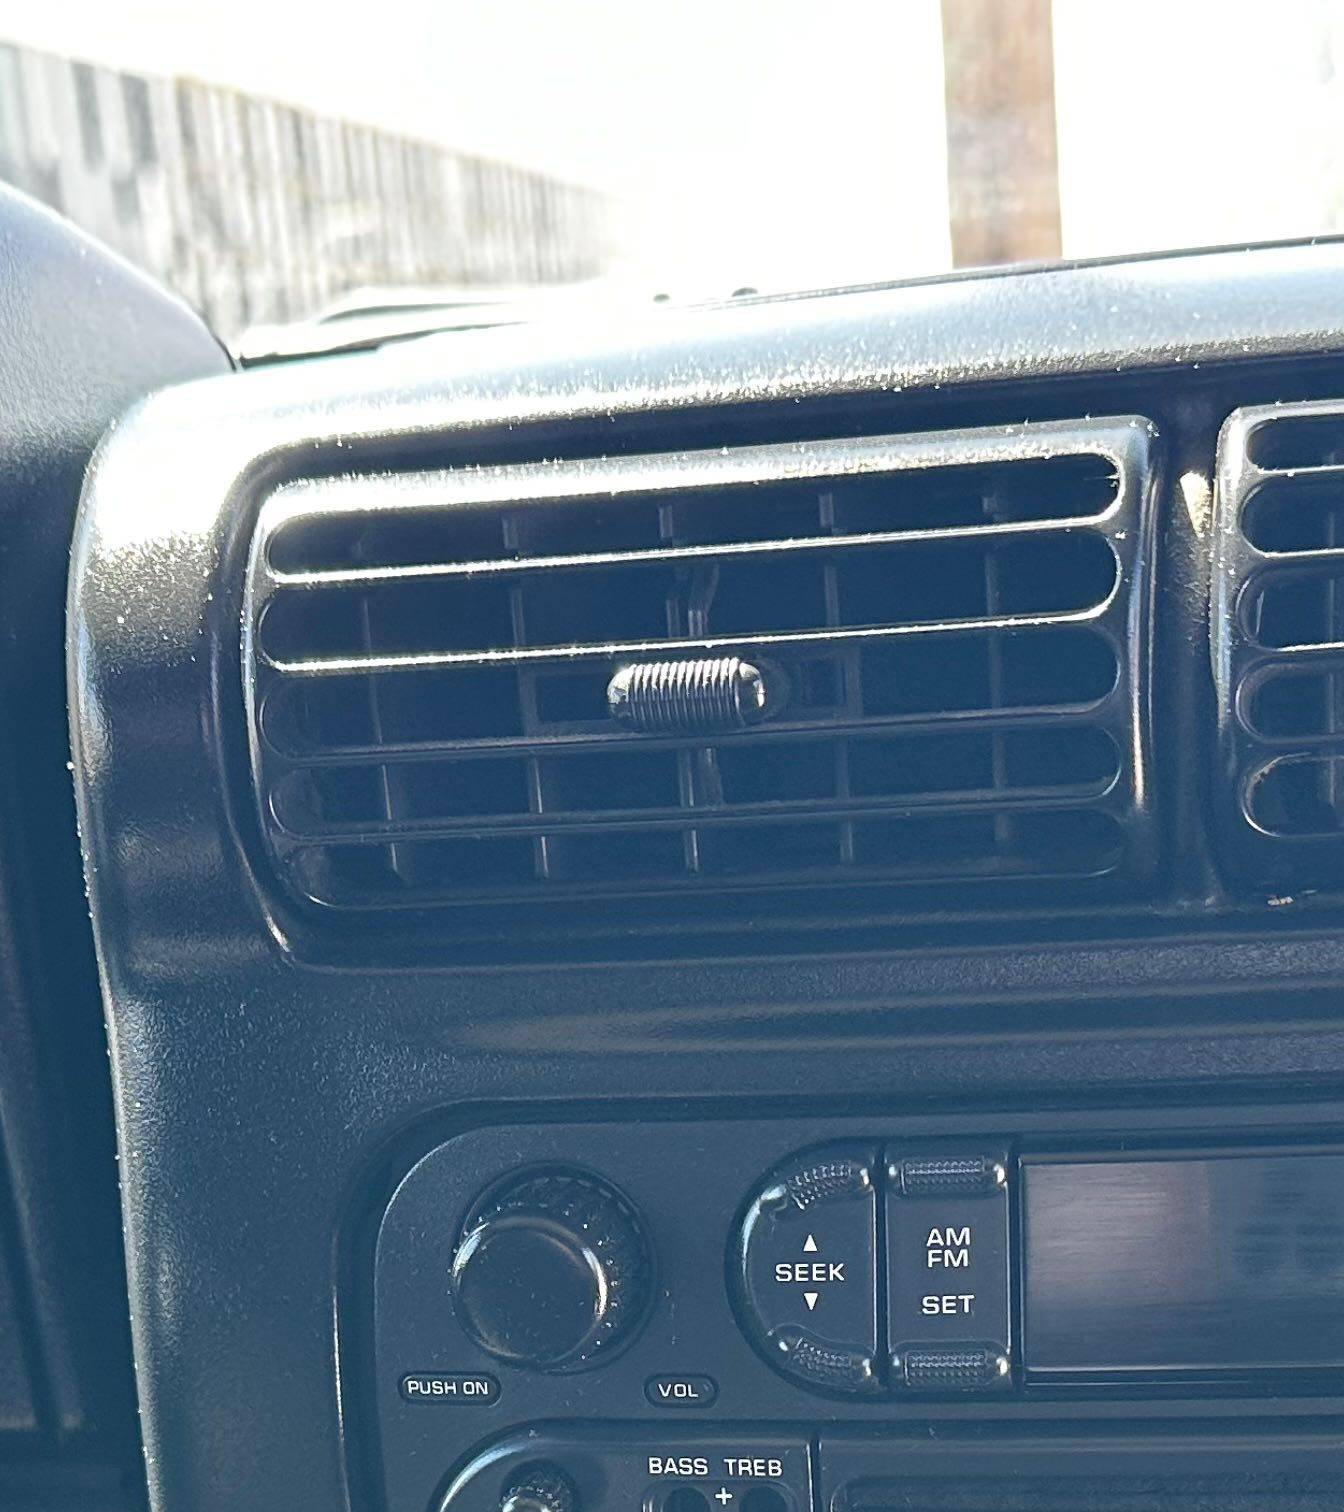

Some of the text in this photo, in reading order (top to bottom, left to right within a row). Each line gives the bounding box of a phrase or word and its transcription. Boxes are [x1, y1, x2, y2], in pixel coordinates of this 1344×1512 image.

[926, 1227, 972, 1246] AM
[927, 1249, 970, 1269] FM
[775, 1262, 846, 1283] SEEK
[922, 1294, 975, 1315] SET
[406, 1380, 489, 1396] PUSH ON
[658, 1383, 699, 1398] VOL
[648, 1457, 784, 1478] BASS TREB
